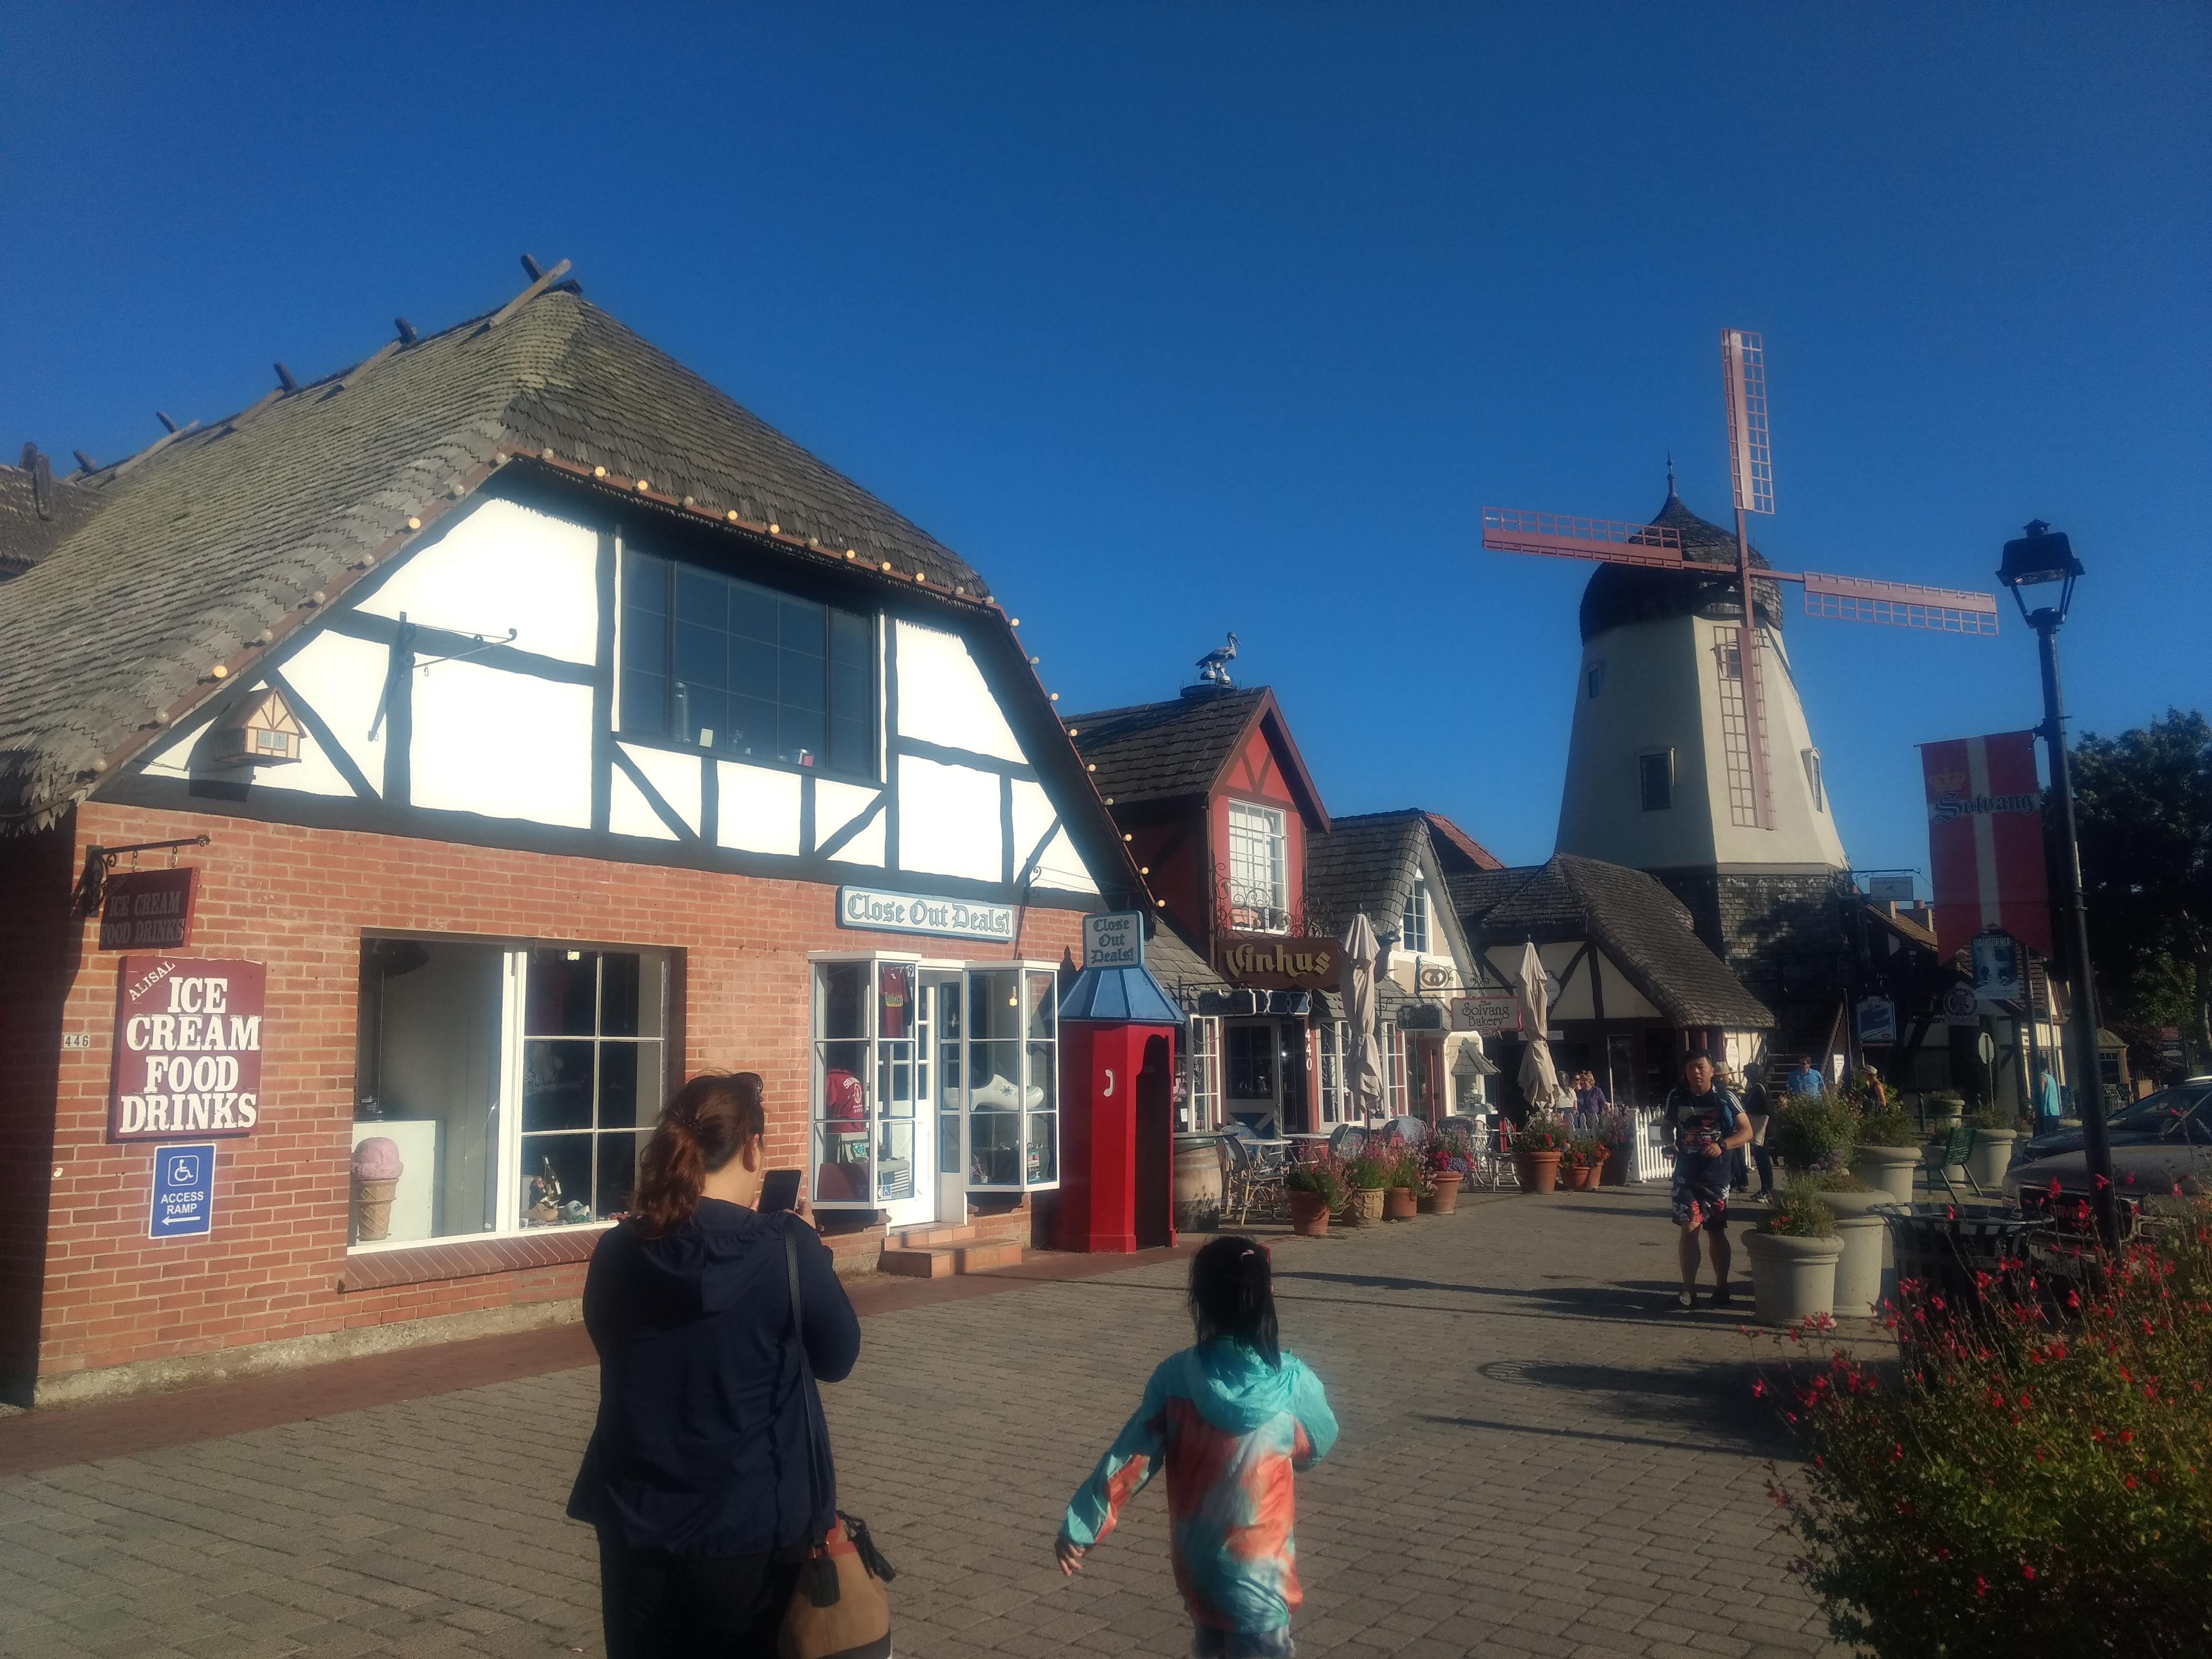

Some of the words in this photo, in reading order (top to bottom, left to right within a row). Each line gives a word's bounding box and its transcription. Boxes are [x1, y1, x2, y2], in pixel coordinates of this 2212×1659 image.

[1933, 791, 2035, 824] Solvang
[108, 895, 131, 917] ICE
[134, 891, 181, 916] CREAM
[847, 894, 905, 922] Close
[909, 900, 949, 927] Out
[951, 904, 1010, 934] Deals!
[100, 922, 131, 944] FOOD
[134, 918, 185, 944] DRINKS
[1093, 916, 1130, 932] Close
[1098, 933, 1125, 948] Out
[1974, 937, 2011, 947] CALIFORNIA
[1091, 948, 1133, 963] Deals!
[1226, 944, 1331, 979] Vinhus
[127, 961, 176, 1002] ALISAL
[908, 966, 914, 976] 9
[168, 977, 228, 1014] ICE
[1462, 1002, 1510, 1019] Solvang
[1468, 1016, 1503, 1029] Bakery
[64, 1035, 89, 1047] 446
[126, 1015, 262, 1052] CREAM
[143, 1056, 239, 1094] FOOD
[119, 1093, 257, 1134] DRINKS
[160, 1191, 204, 1203] ACCESS
[166, 1202, 197, 1214] RAMP
